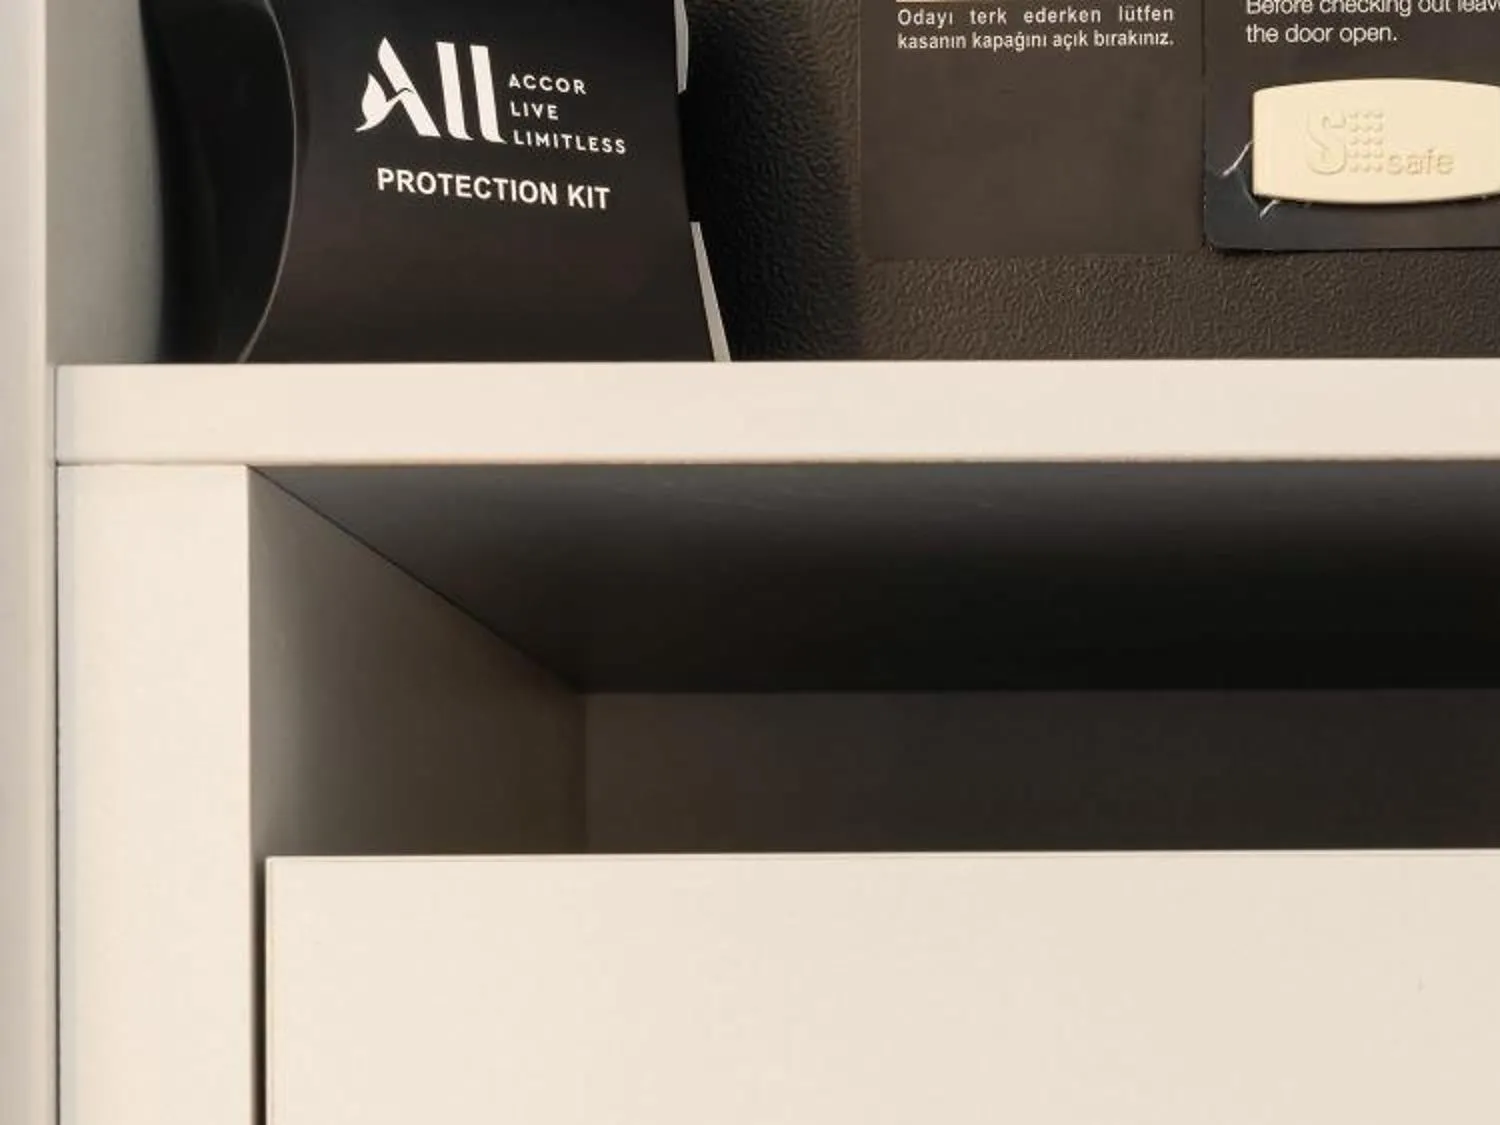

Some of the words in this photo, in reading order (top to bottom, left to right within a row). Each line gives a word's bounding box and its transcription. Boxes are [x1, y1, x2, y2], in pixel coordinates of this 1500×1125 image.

[897, 8, 953, 28] Odayı
[970, 8, 1007, 25] terk
[1023, 7, 1101, 24] ederken
[1119, 5, 1174, 23] lütfen
[1246, 0, 1313, 14] Before
[1319, 0, 1412, 17] checking
[1417, 0, 1451, 13] out
[897, 33, 967, 49] kasanın
[971, 31, 1047, 52] kapağını
[1052, 30, 1089, 51] açık
[1093, 29, 1175, 47] bırakınız.
[1246, 24, 1279, 43] the
[1285, 23, 1334, 43] door
[1339, 26, 1398, 46] open.
[508, 73, 587, 95] ACCOR
[510, 101, 559, 121] LIVE
[513, 129, 627, 155] LIMITLESS
[377, 167, 558, 206] PROTECTION
[566, 183, 611, 210] KIT
